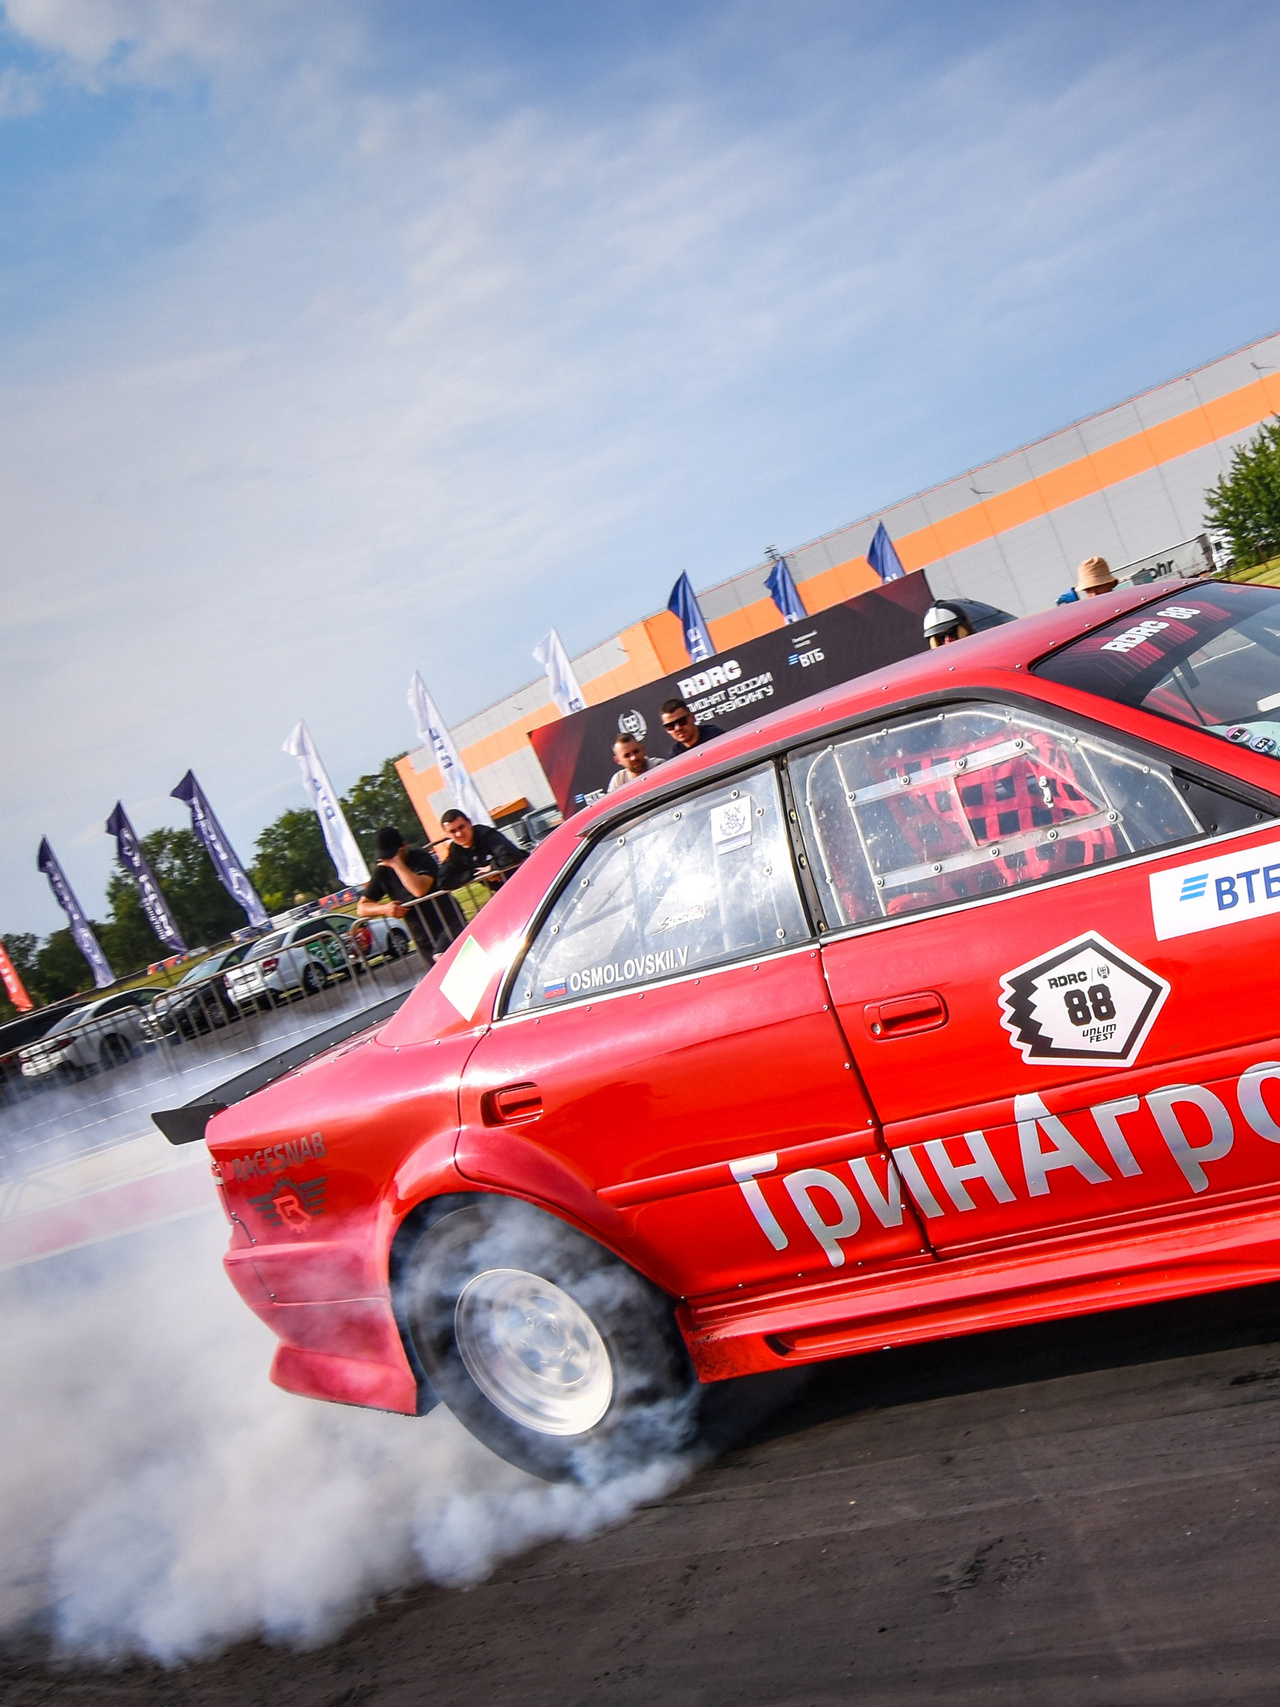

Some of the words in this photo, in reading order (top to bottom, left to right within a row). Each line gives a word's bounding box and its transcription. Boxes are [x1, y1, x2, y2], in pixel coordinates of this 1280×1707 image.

[1100, 620, 1170, 653] RDRC
[1156, 606, 1201, 620] 88
[798, 648, 825, 667] ВТБ
[677, 660, 742, 699] RDRC
[569, 945, 690, 992] OSMOLOVSKII.V
[1047, 971, 1088, 989] RDRC
[1063, 983, 1117, 1027] 88
[1089, 1032, 1114, 1043] FEST
[231, 1131, 327, 1184] RACESNAB
